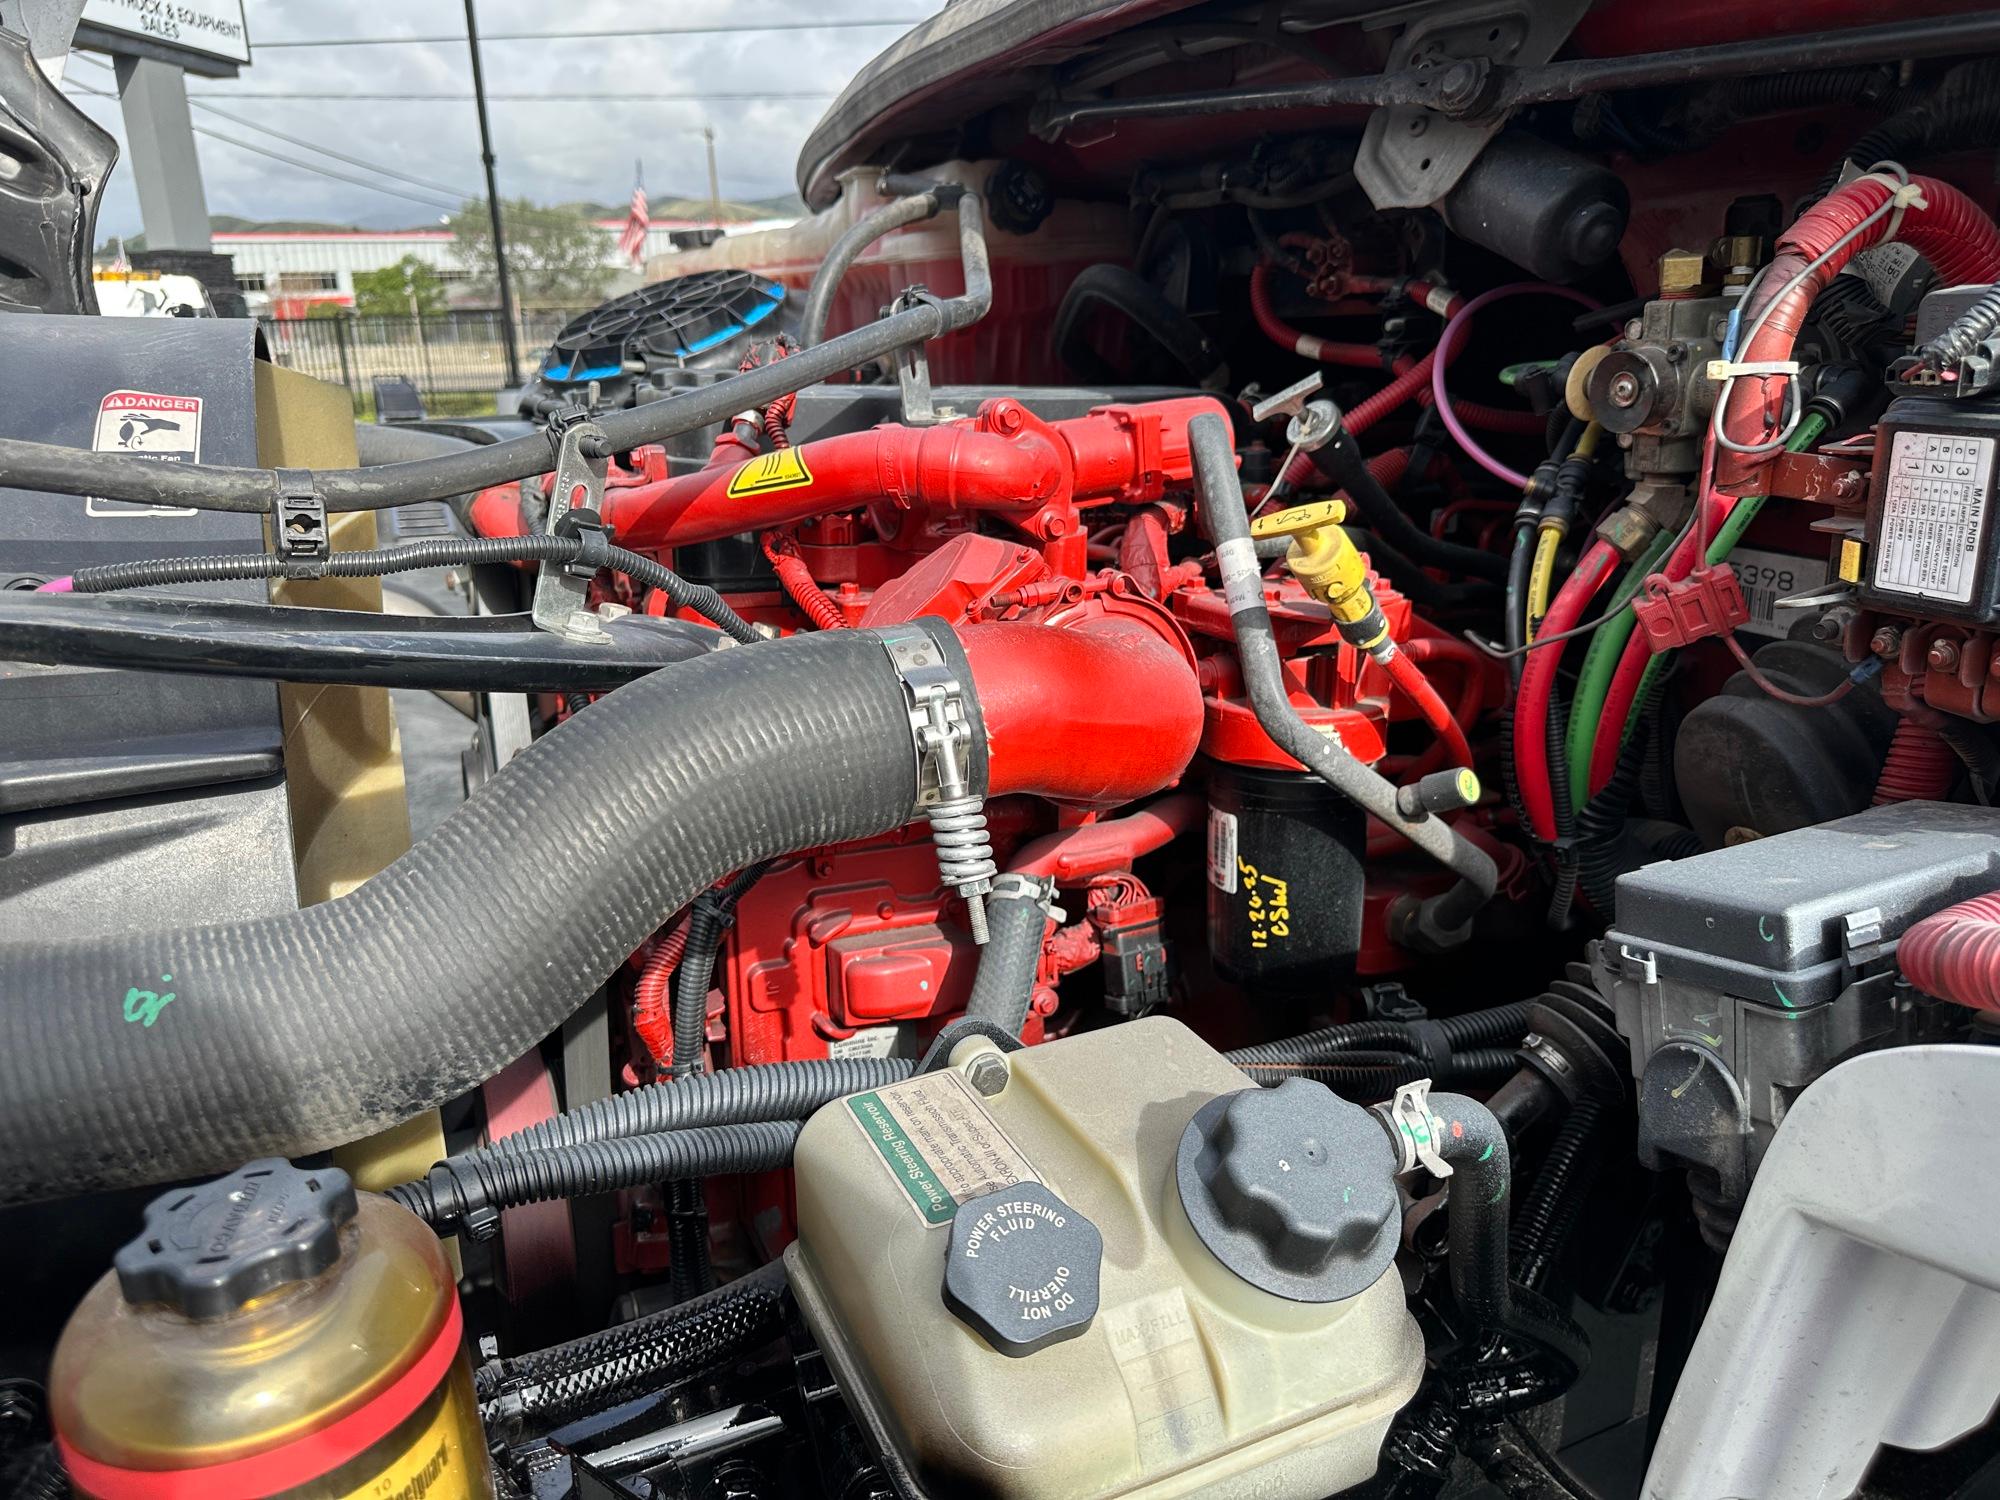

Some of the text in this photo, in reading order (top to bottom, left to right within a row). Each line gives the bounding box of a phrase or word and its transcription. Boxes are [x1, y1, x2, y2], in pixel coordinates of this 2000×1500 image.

[139, 13, 180, 39] SALES
[166, 2, 175, 19] &
[177, 7, 241, 39] EQUIPMENT
[125, 397, 196, 410] DANGER
[1929, 445, 1938, 453] A
[1942, 446, 1950, 454] B
[1968, 448, 1977, 456] D
[1907, 462, 1920, 471] 1
[1931, 464, 1944, 475] 2
[1956, 466, 1970, 477] 3
[1965, 488, 1983, 552] MAIN PNDB
[1952, 526, 1964, 568] DESCRIPTION
[911, 1089, 928, 1106] Fluid
[910, 1115, 921, 1126] on
[925, 1100, 959, 1146] Transmission
[965, 1119, 984, 1143] Super
[917, 1124, 934, 1144] mark
[862, 1101, 947, 1212] Power Steering Reservoir
[932, 1143, 964, 1187] appropriate
[958, 1145, 988, 1181] Automatic
[986, 1147, 1020, 1185] EXRON-III
[960, 1182, 972, 1194] to
[966, 1201, 1066, 1258] POWER STEERING
[990, 1217, 1035, 1242] FLUID
[1008, 1266, 1070, 1303] OVERFILL
[1021, 1292, 1075, 1320] DO NOT
[373, 1478, 393, 1497] 10
